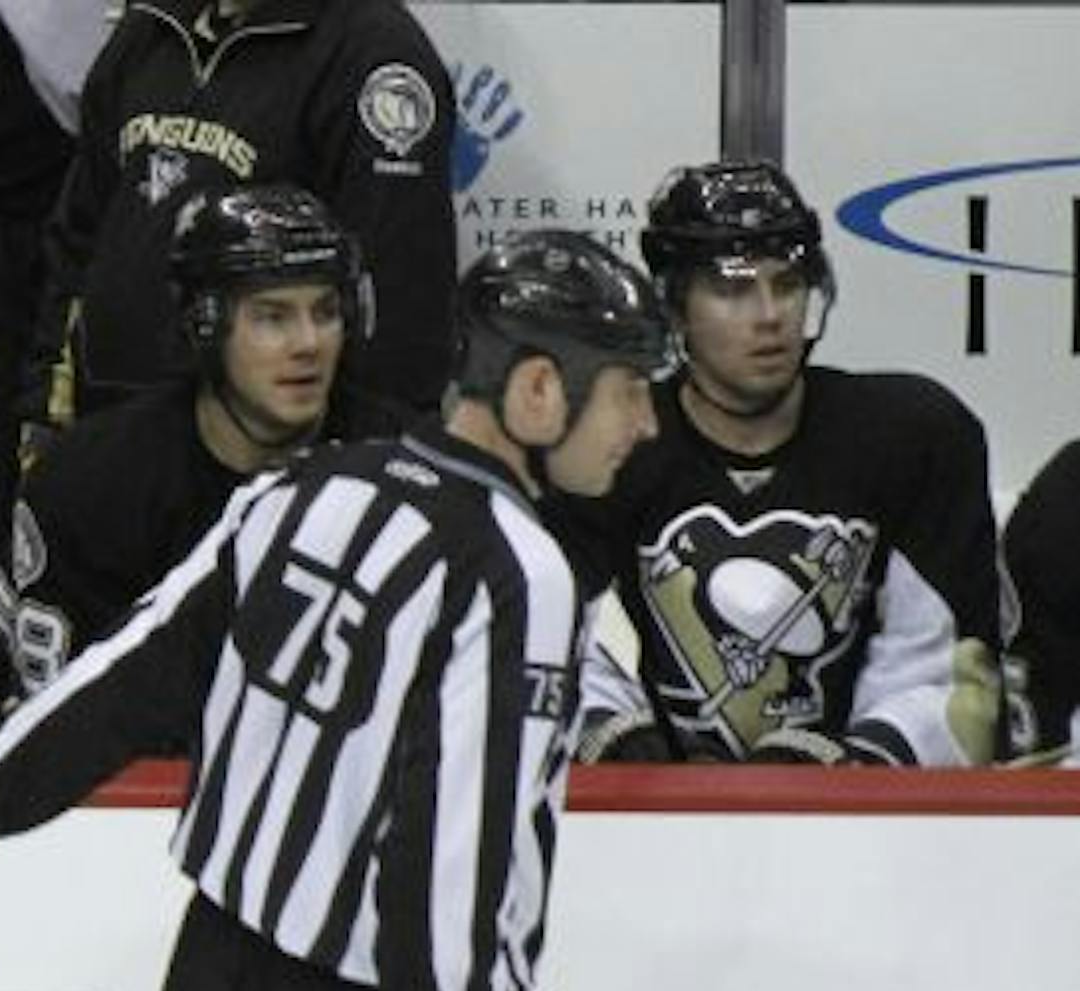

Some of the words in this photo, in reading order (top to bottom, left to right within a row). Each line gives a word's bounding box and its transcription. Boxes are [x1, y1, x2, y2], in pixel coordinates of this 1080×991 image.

[461, 197, 558, 218] ATER
[588, 197, 636, 218] HA
[267, 560, 367, 713] 75
[523, 668, 566, 716] 75
